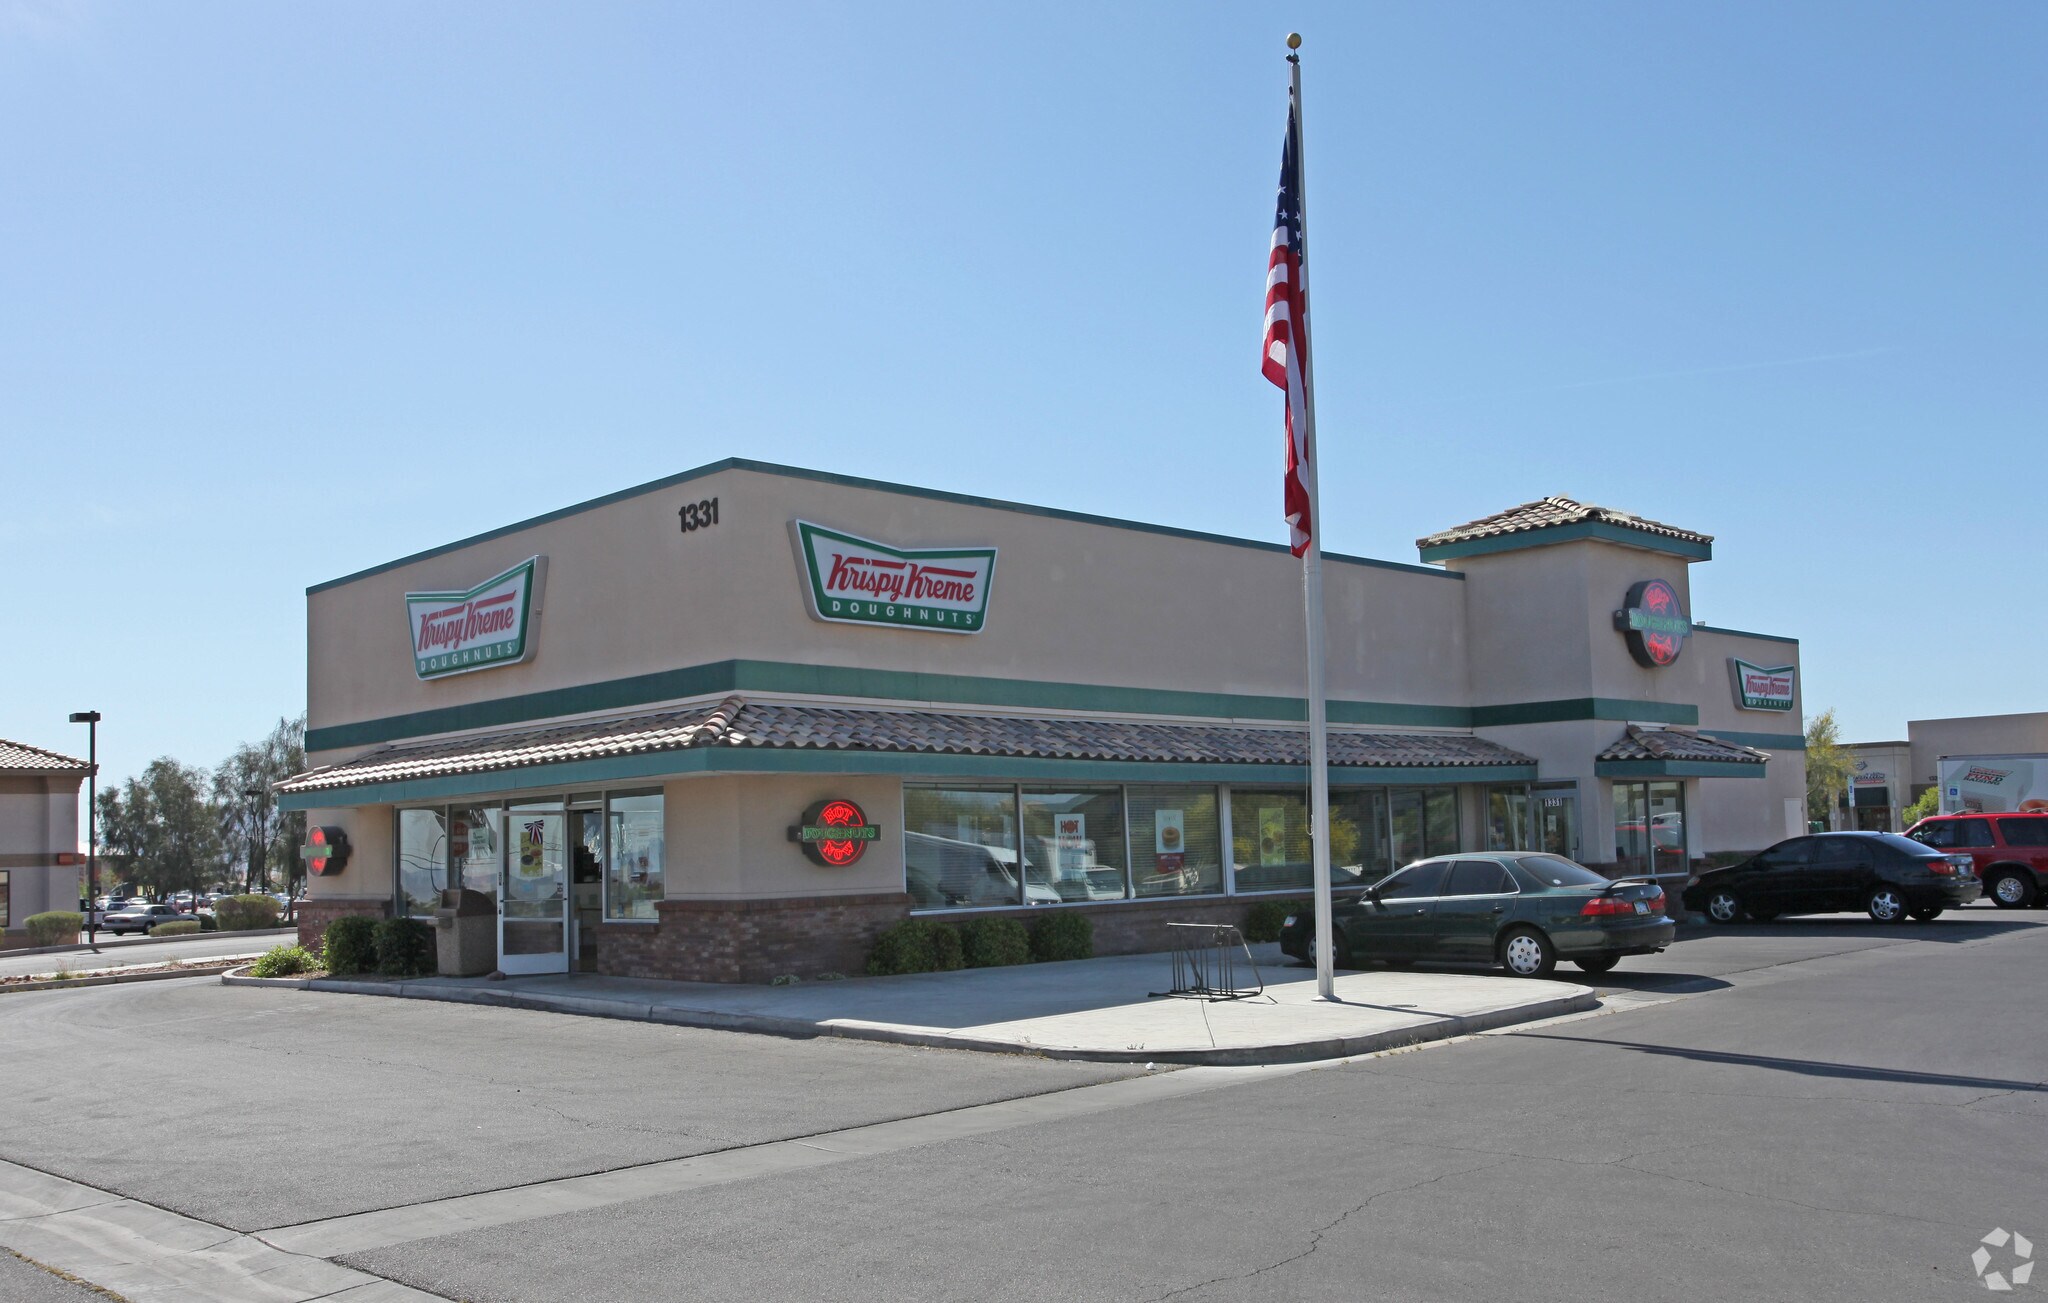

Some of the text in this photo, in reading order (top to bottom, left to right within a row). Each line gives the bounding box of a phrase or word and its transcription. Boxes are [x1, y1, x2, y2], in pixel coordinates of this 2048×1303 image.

[679, 497, 719, 532] 1331
[827, 553, 977, 602] Krispy Kreme
[417, 589, 517, 651] Krispy Kreme
[832, 600, 974, 625] DOUGHNUTS
[420, 642, 513, 671] DOUGHNUTS
[823, 805, 854, 824] HOT
[1545, 798, 1563, 807] 1331
[1060, 819, 1079, 834] HOT
[823, 840, 854, 861] NOW
